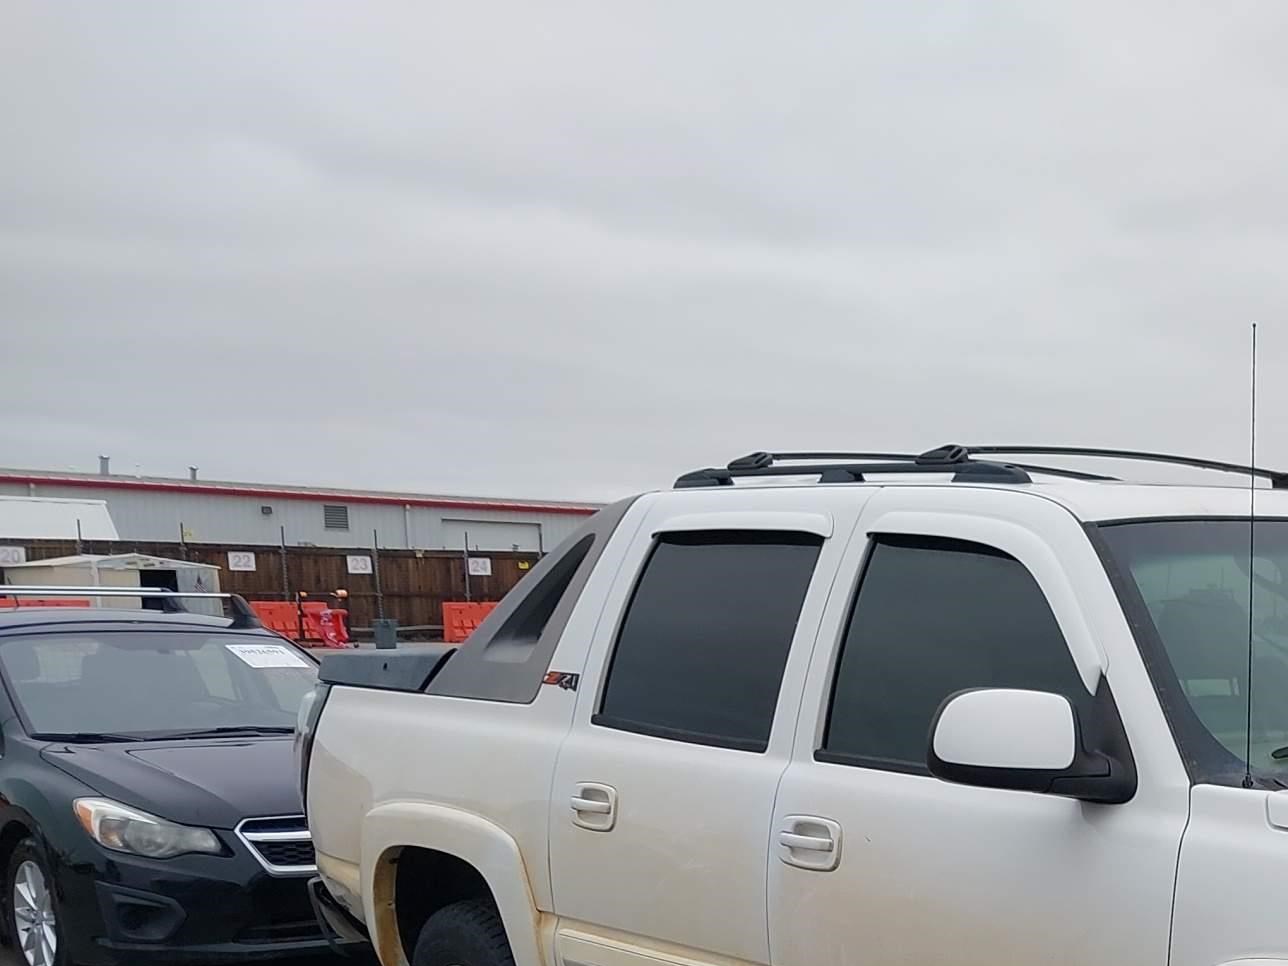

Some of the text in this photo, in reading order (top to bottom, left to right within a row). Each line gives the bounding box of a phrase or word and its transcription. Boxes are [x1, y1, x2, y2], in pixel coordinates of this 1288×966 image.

[232, 554, 251, 568] 22
[351, 557, 368, 570] 23
[471, 560, 488, 573] 24
